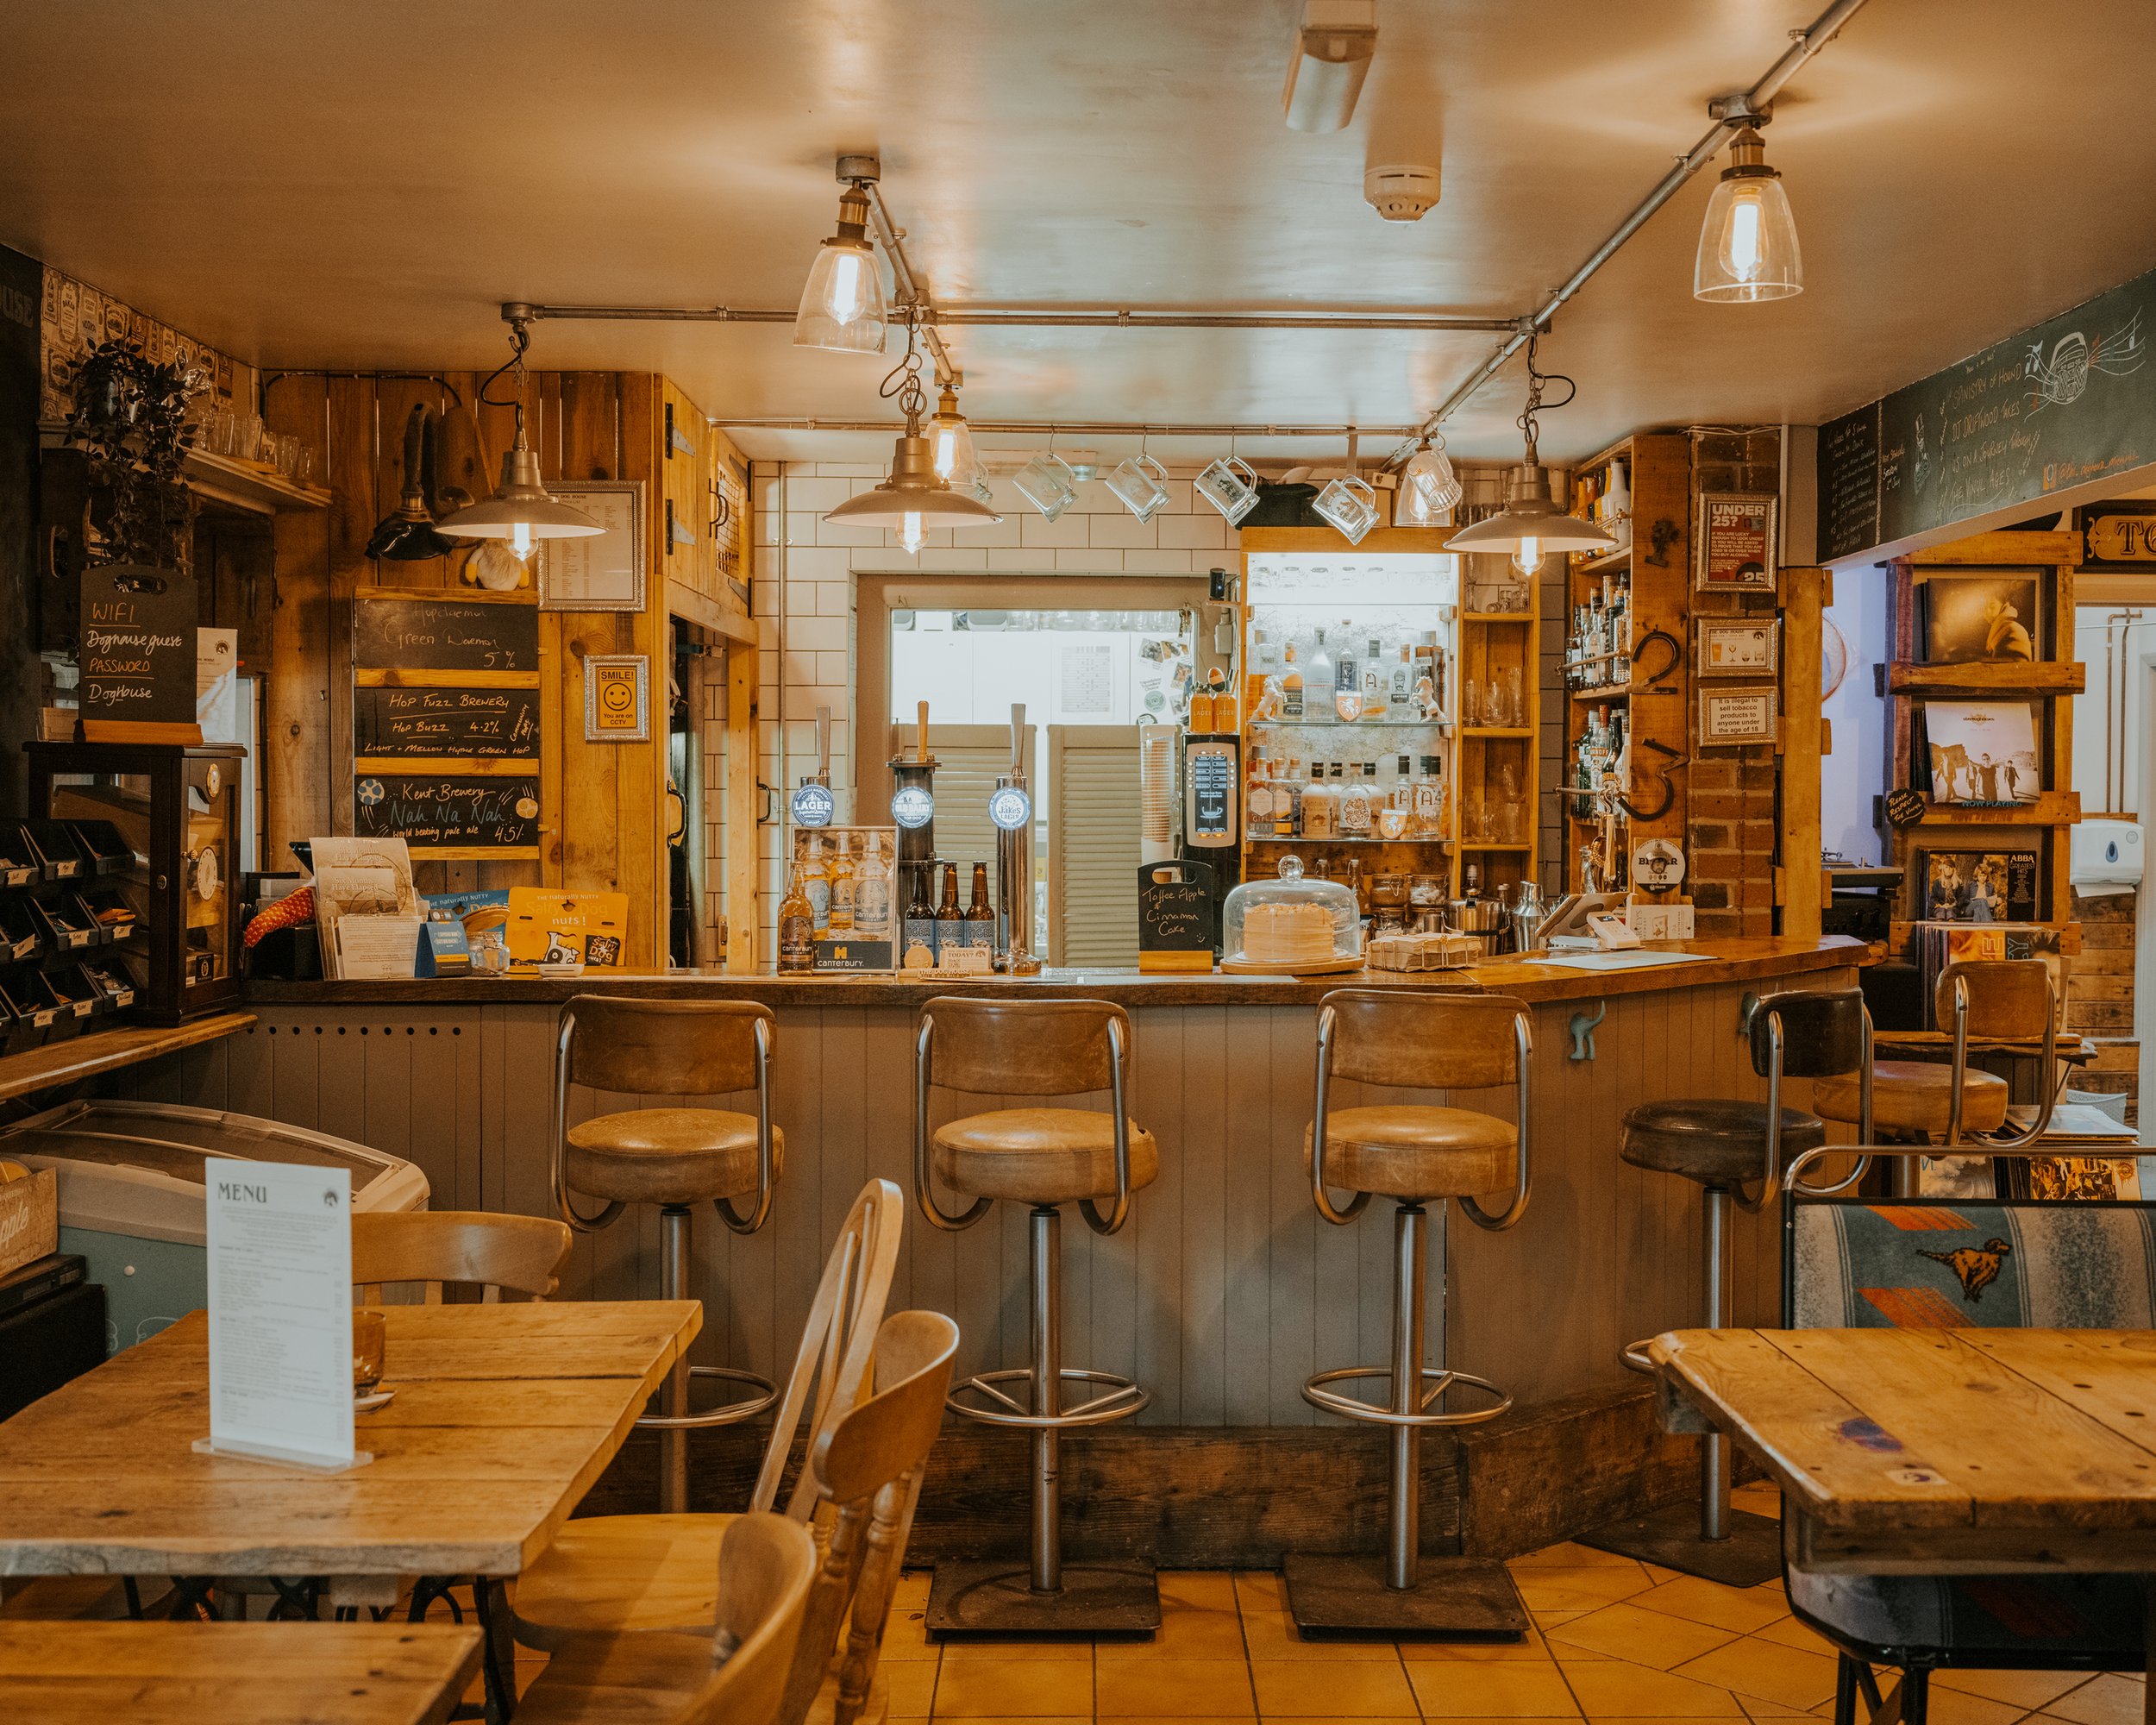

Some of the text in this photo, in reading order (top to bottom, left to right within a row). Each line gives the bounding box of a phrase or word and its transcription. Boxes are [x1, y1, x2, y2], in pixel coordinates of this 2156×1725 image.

[0, 285, 34, 328] USE
[1712, 505, 1765, 516] UNDER
[1712, 516, 1738, 527] 25?
[1744, 572, 1765, 581] 25
[92, 602, 135, 622] WIFI
[385, 620, 435, 649] Green
[145, 634, 183, 656] guest
[89, 658, 151, 673] PASSWORD
[601, 671, 634, 680] SMILE!
[460, 694, 510, 708] BREWERY
[403, 783, 496, 806] Kent Brewery
[795, 800, 830, 810] LAGER
[390, 800, 505, 827] Nah Na Nah
[444, 825, 461, 839] pale
[467, 825, 479, 835] ale
[440, 895, 468, 905] naturally
[1142, 886, 1206, 903] Toffee Apple
[579, 902, 608, 917] Dog
[1158, 921, 1185, 936] Cake
[589, 946, 613, 962] Dog
[218, 1182, 267, 1203] MENU
